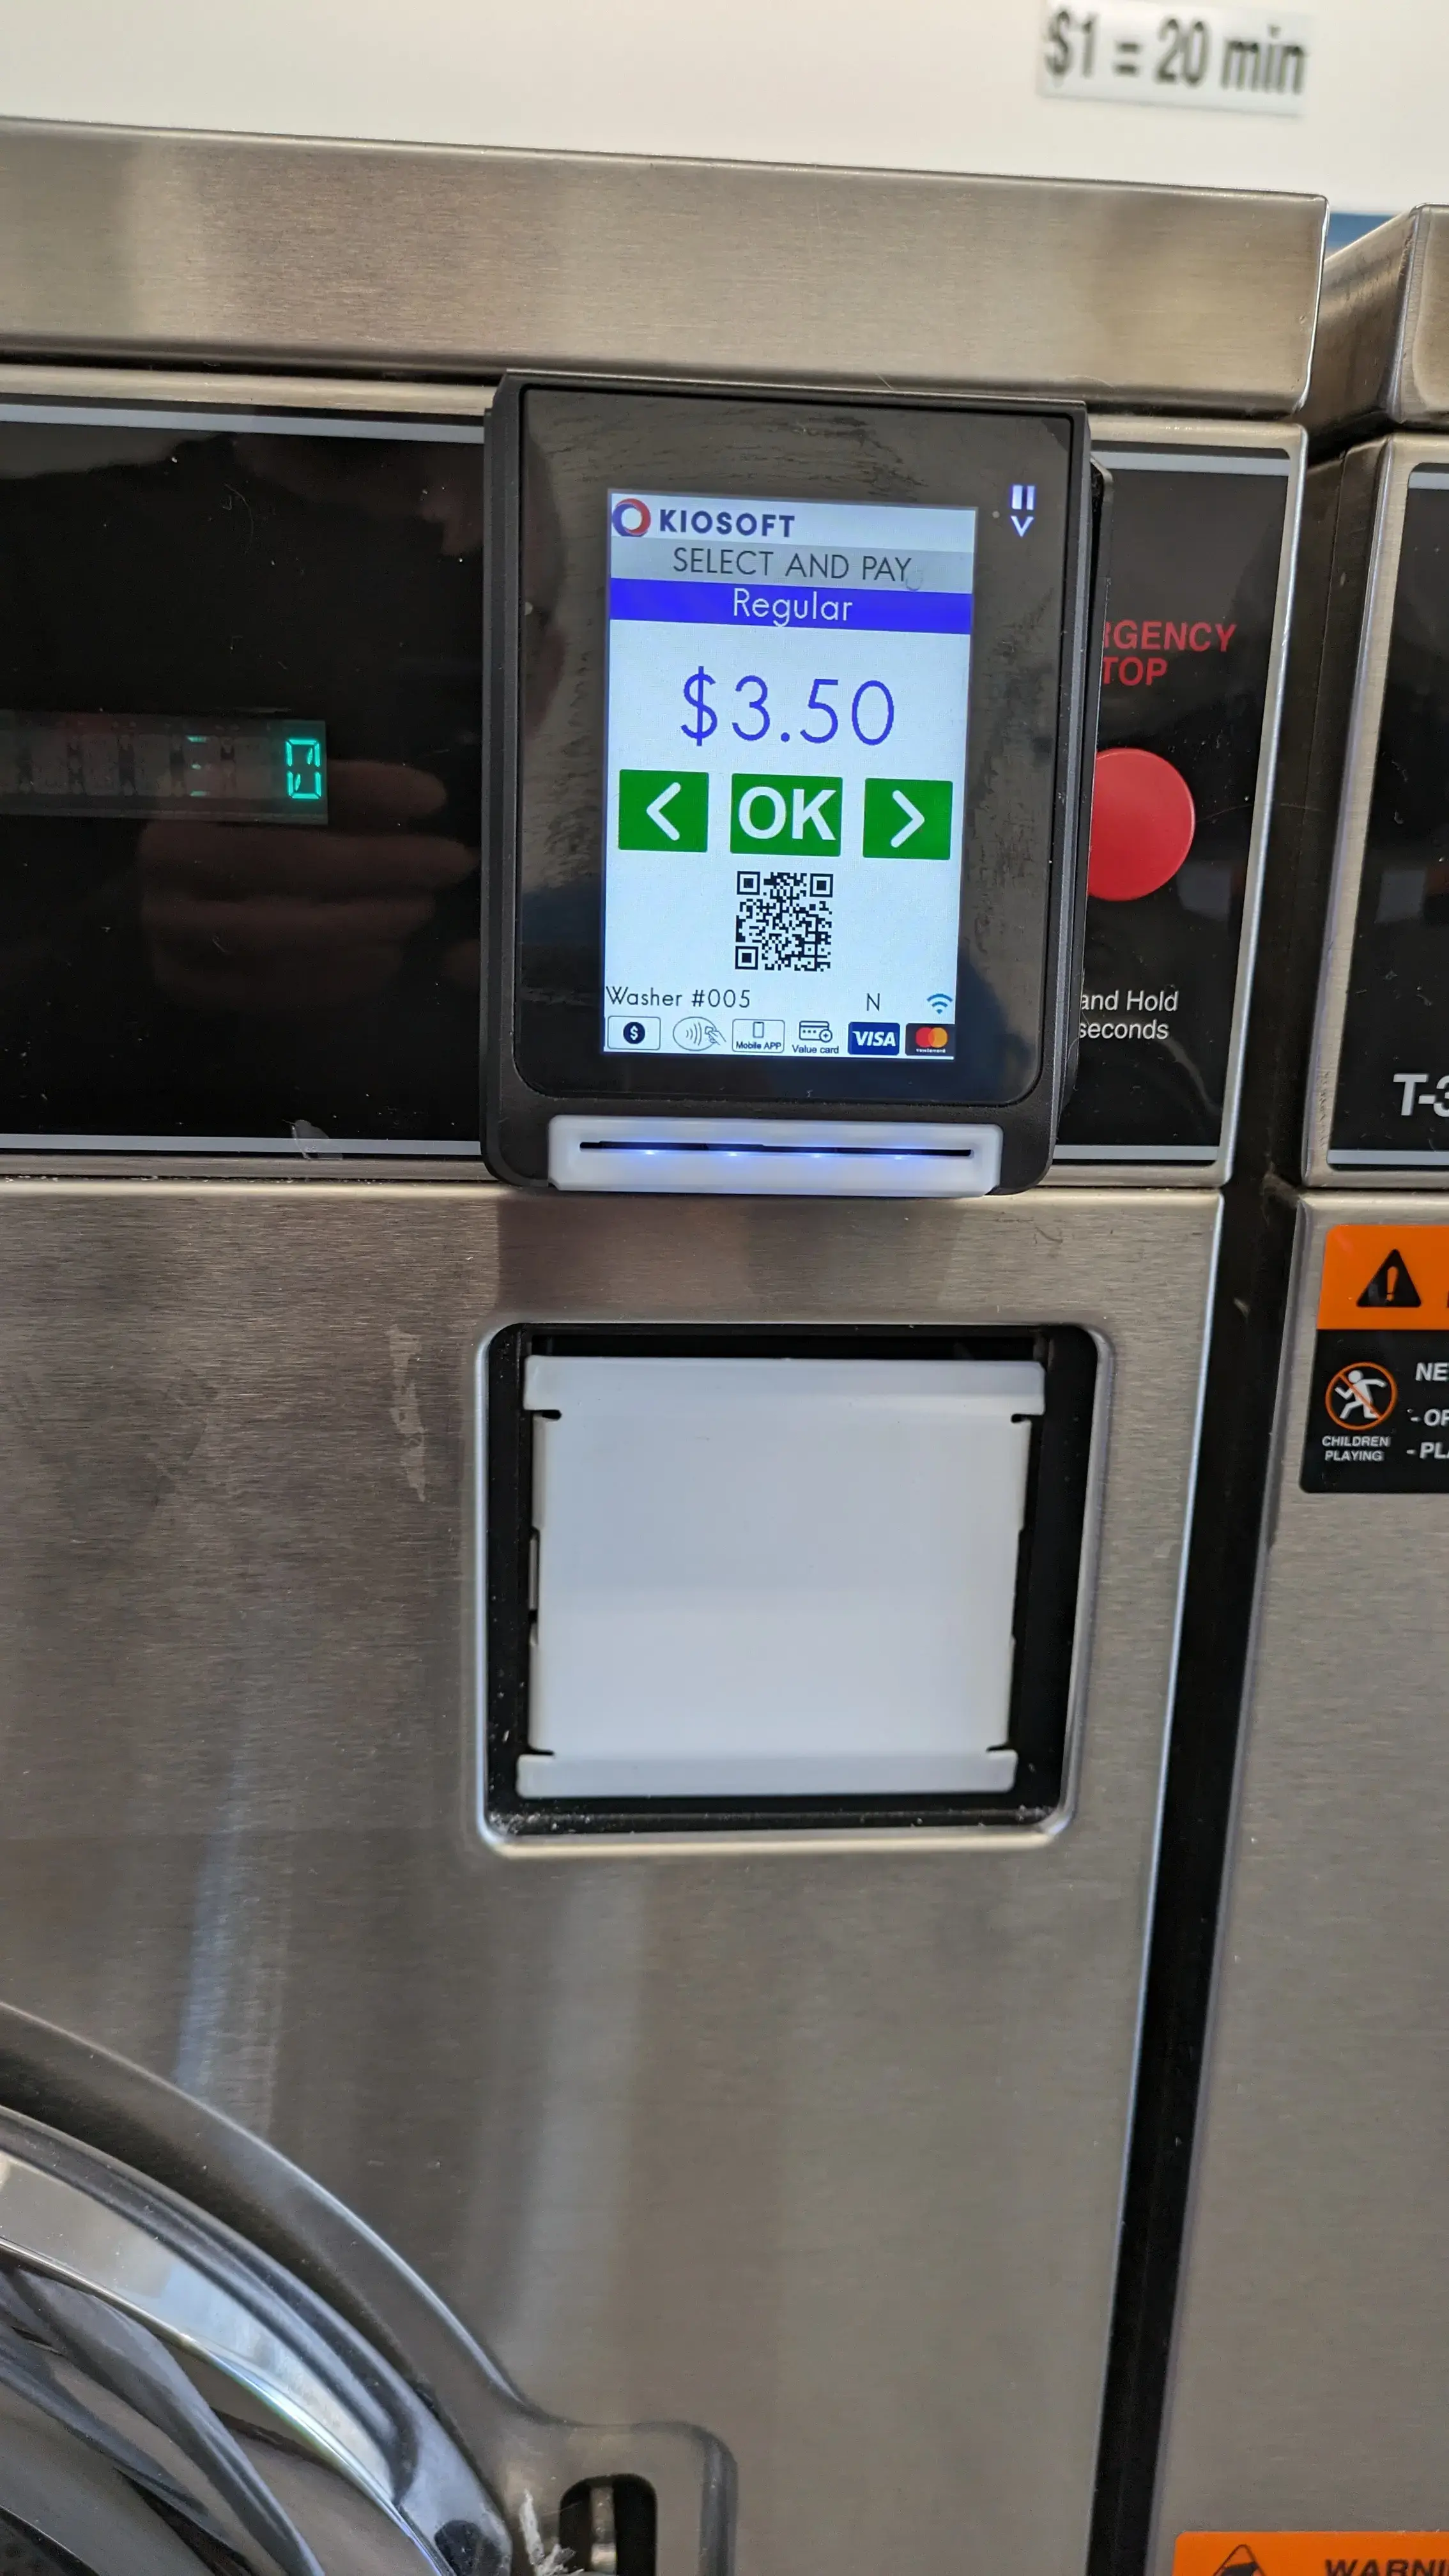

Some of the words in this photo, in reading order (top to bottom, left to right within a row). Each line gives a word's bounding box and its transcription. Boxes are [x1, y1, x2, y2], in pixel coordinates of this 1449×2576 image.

[1046, 9, 1095, 86] $1
[1114, 41, 1141, 76] =
[1154, 18, 1209, 86] 20
[1220, 26, 1306, 94] min
[660, 509, 795, 538] KIOSOFT
[673, 548, 774, 575] SELECT
[785, 553, 849, 579] AND
[862, 556, 912, 581] PAY
[733, 588, 853, 627] Regular
[680, 666, 895, 747] $3.50
[286, 739, 322, 799] 0
[738, 786, 837, 841] OK
[606, 986, 683, 1006] Washer
[691, 989, 750, 1008] #005
[866, 993, 880, 1011] N
[1082, 990, 1119, 1011] and
[1126, 990, 1179, 1011] Hold
[852, 1031, 896, 1046] VISA
[1080, 1018, 1169, 1040] seconds
[736, 1041, 762, 1050] Mobile
[792, 1045, 817, 1054] Value
[820, 1045, 839, 1054] card
[1415, 1362, 1449, 1381] NE
[1322, 1436, 1390, 1447] CHILDREN
[1420, 1442, 1449, 1459] PL
[1324, 1450, 1384, 1461] PLAYING
